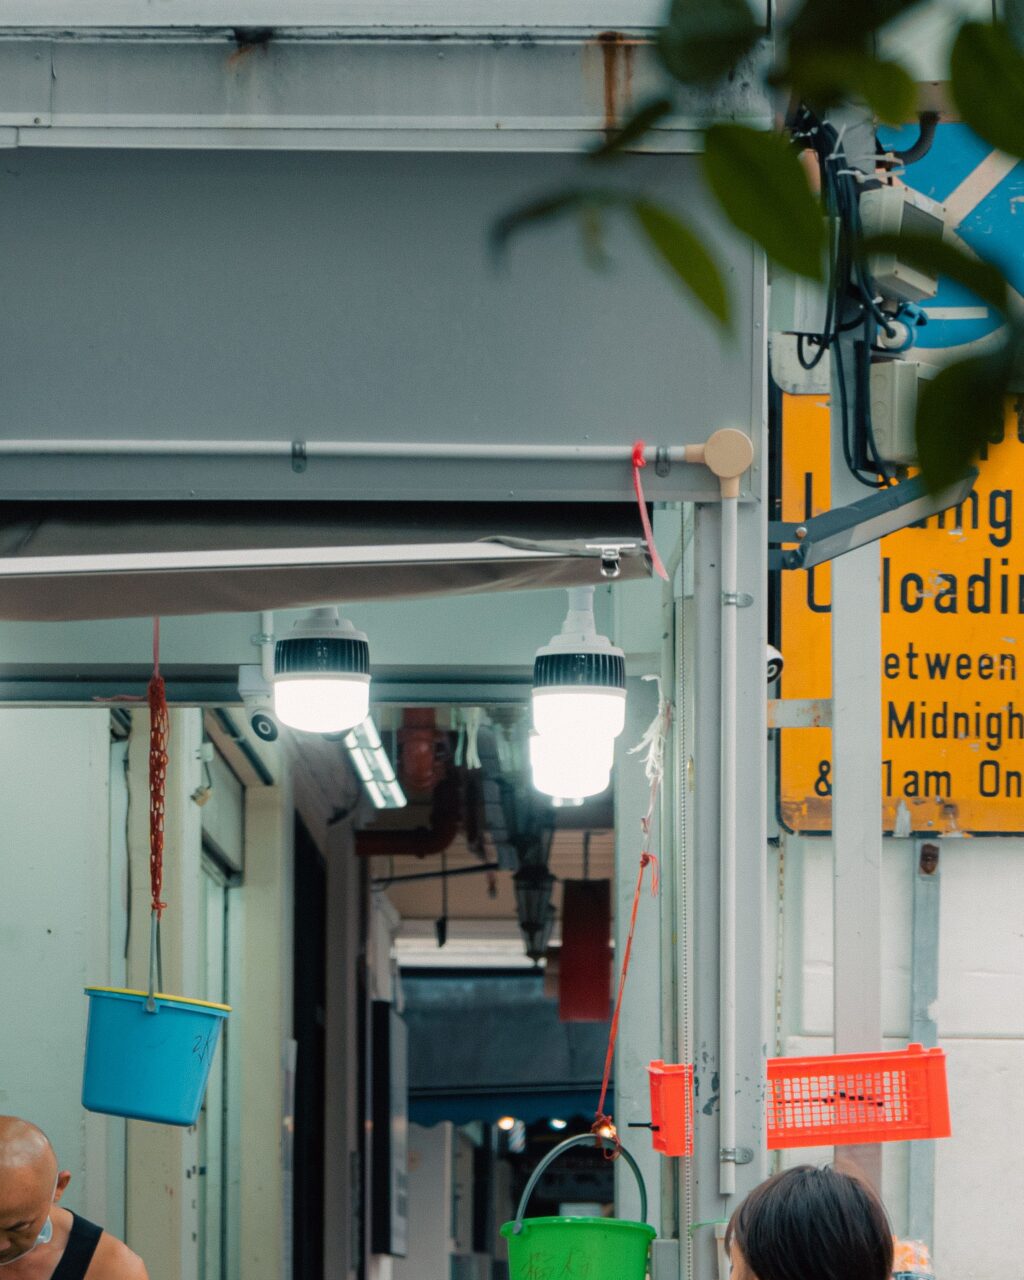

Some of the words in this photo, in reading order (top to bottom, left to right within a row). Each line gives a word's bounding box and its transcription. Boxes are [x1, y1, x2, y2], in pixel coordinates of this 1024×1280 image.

[807, 558, 1024, 613] Uloadi
[884, 643, 1016, 680] etween
[815, 760, 832, 797] &
[978, 759, 1022, 797] On
